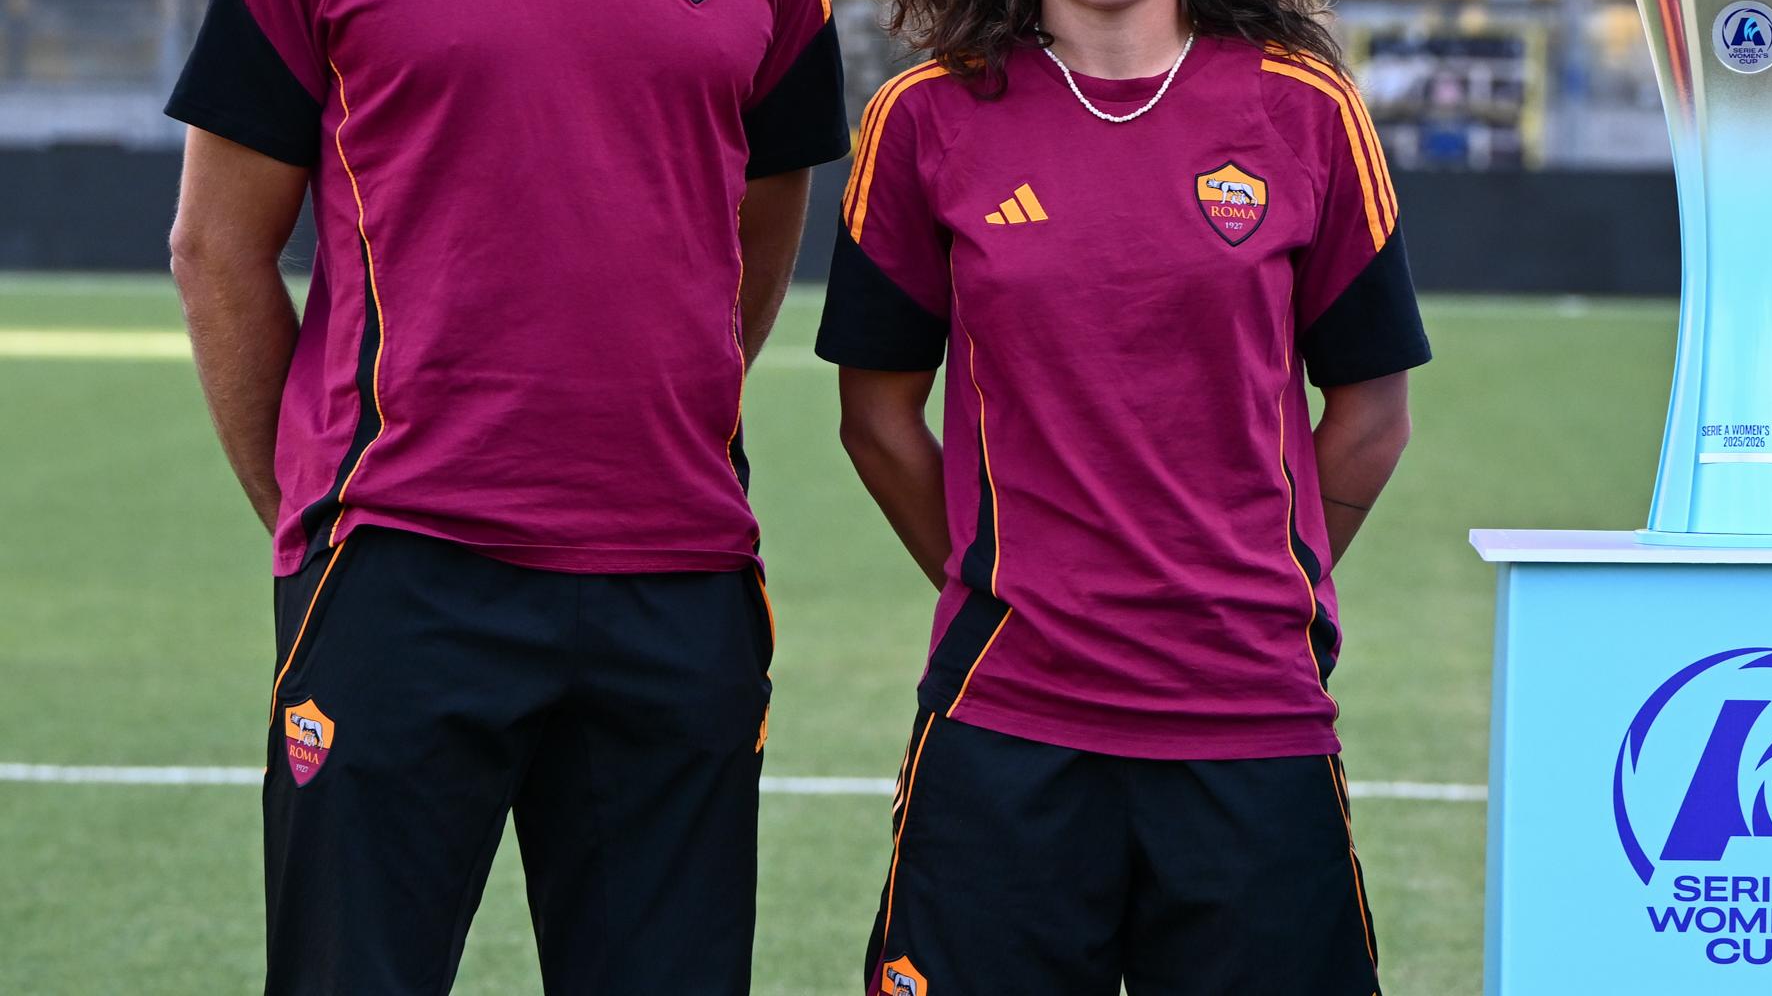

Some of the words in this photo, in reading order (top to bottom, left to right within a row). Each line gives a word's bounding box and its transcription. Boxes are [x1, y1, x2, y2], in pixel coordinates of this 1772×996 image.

[1210, 205, 1257, 220] ROMA
[1225, 221, 1243, 230] 1927
[1701, 424, 1722, 437] SERIE
[1724, 424, 1730, 436] A
[1731, 424, 1770, 436] WOMEN'S
[1723, 436, 1766, 447] 2025/2026
[289, 744, 320, 765] ROMA
[295, 763, 309, 773] 1927
